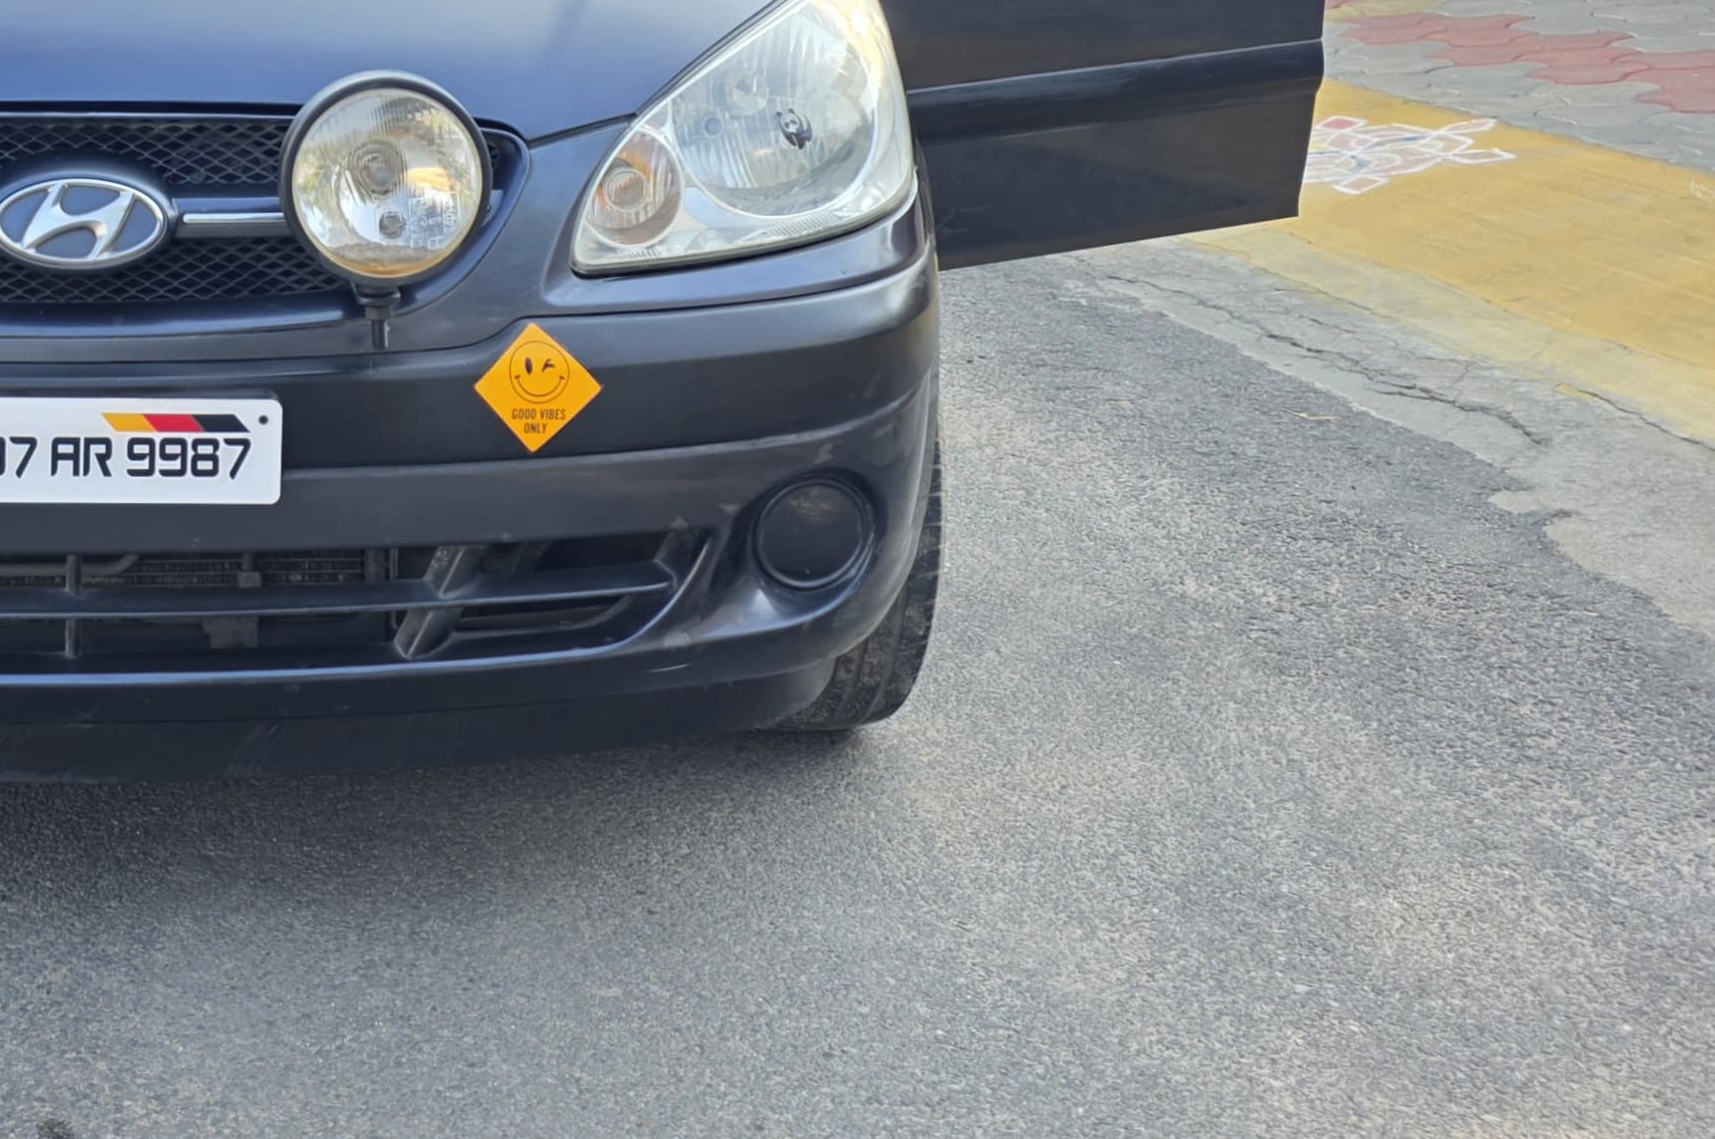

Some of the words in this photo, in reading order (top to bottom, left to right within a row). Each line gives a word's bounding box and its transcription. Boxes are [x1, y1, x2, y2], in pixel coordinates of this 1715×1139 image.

[511, 408, 537, 420] GOOD
[540, 409, 566, 421] VIBES
[523, 423, 548, 434] ONLY
[50, 436, 113, 478] AR
[126, 437, 252, 480] 9987
